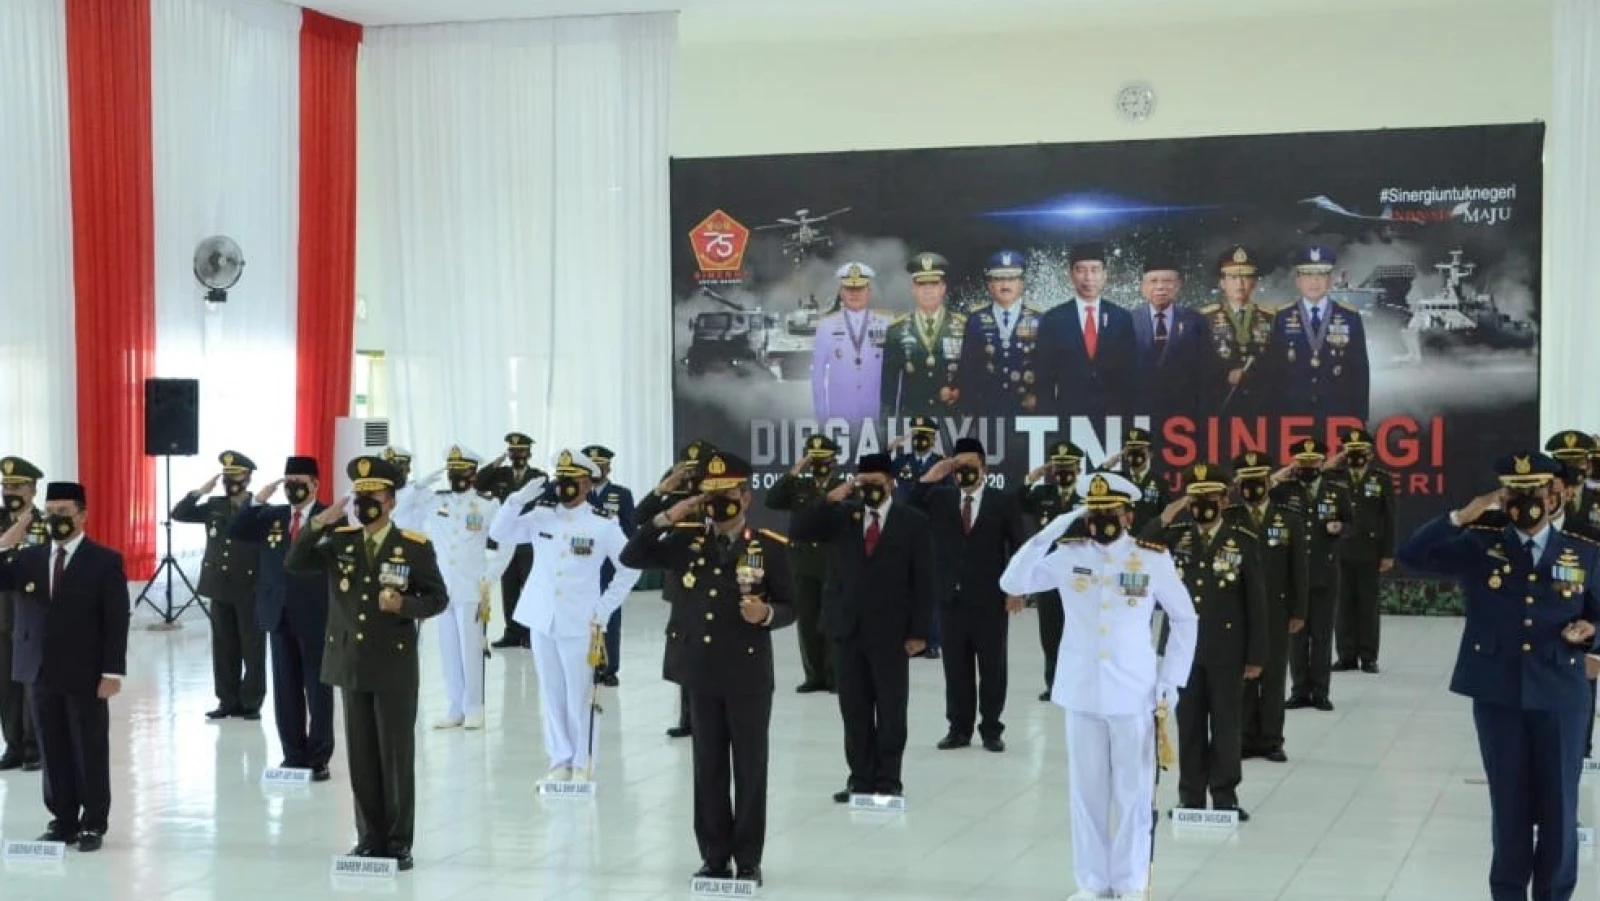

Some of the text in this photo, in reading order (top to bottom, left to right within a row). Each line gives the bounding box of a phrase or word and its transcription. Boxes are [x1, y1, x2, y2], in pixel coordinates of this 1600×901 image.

[1379, 184, 1517, 205] #Sinergiuntuknegeri
[1463, 207, 1512, 226] MAJU
[703, 231, 736, 258] 75
[1014, 415, 1151, 484] TN
